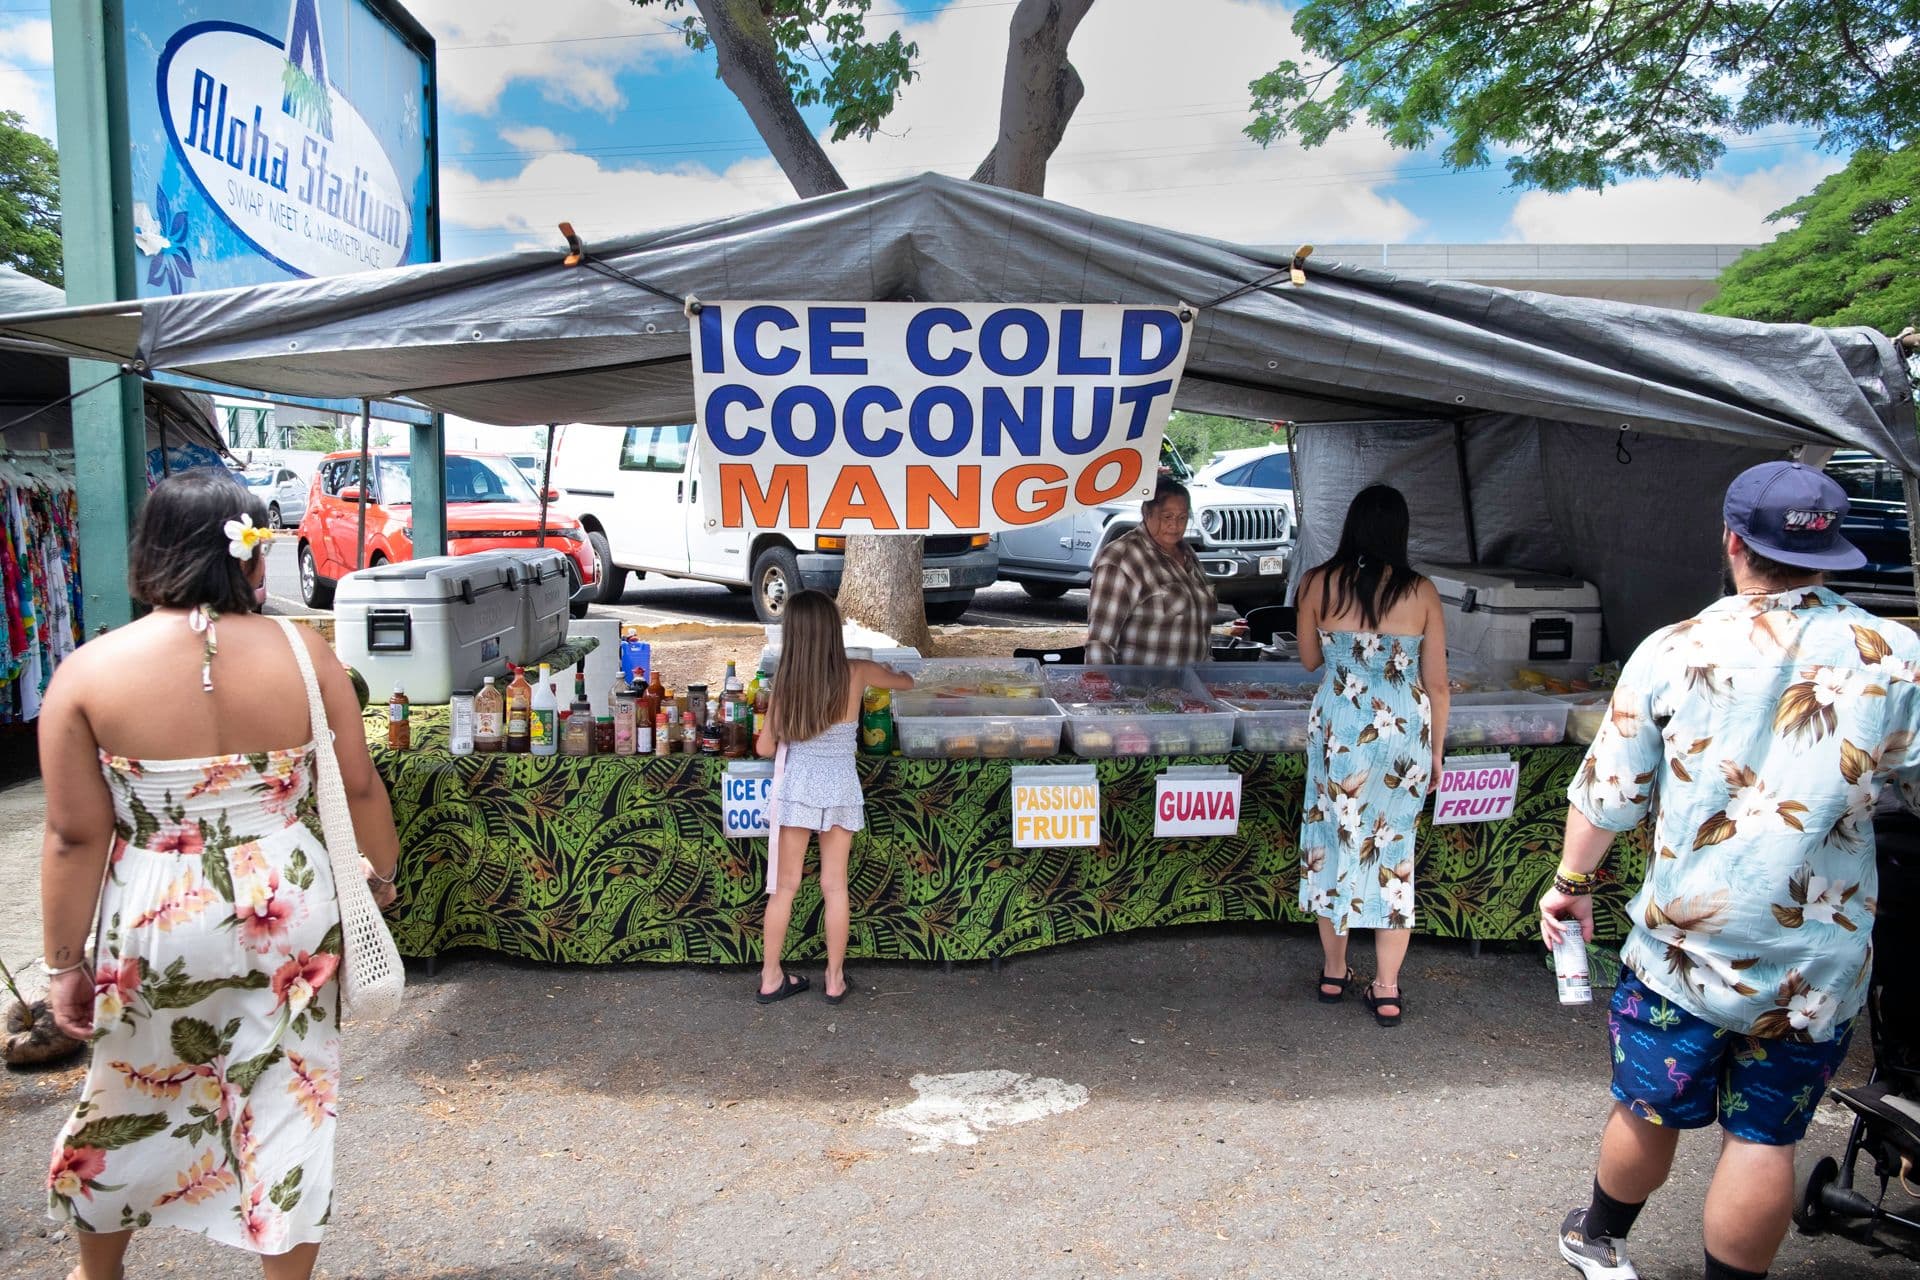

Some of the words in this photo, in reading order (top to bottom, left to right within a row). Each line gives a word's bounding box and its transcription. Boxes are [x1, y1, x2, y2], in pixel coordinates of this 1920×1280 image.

[184, 68, 288, 193] Aloha
[297, 135, 400, 249] Stadium
[227, 179, 263, 217] SWAP
[269, 201, 298, 232] MEET
[304, 215, 312, 238] &
[317, 223, 381, 269] MARKETPLACE
[699, 305, 868, 376] ICE
[905, 307, 1183, 377] COLD
[705, 379, 1172, 457] COCONUT
[719, 448, 1142, 530] MANGO
[727, 779, 756, 801] ICE
[1440, 769, 1515, 792] DRAGON
[1016, 784, 1096, 811] PASSION
[1159, 790, 1235, 822] GUAVA
[1438, 796, 1512, 817] FRUIT
[728, 809, 770, 830] COC
[1017, 815, 1096, 841] FRUIT
